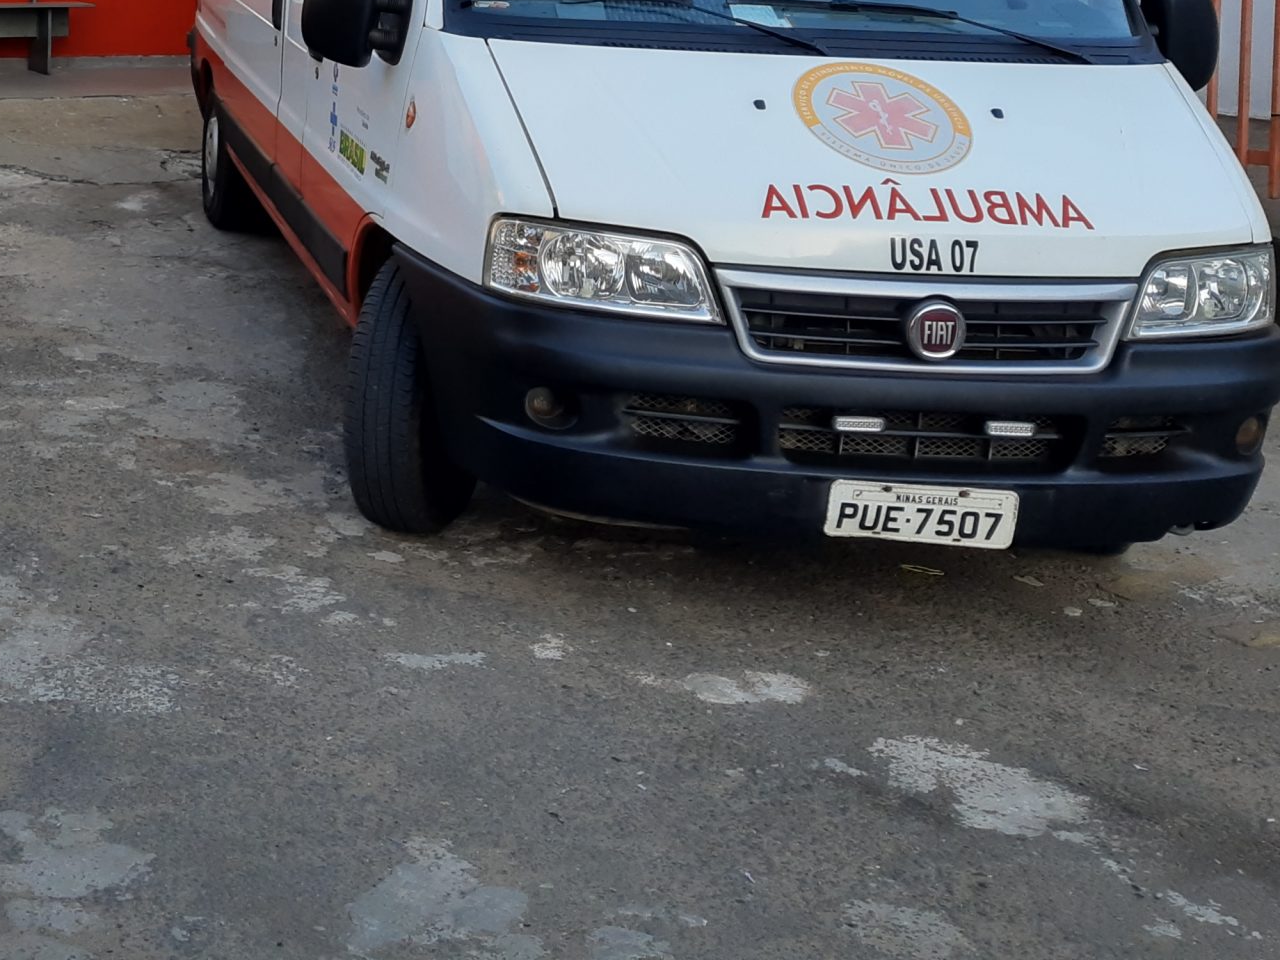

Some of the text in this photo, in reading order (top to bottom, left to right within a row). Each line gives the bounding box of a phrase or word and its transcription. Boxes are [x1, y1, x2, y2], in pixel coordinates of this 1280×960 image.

[890, 237, 979, 273] USA 07
[923, 321, 955, 345] FIAT
[895, 493, 959, 506] MINAS GERAIS
